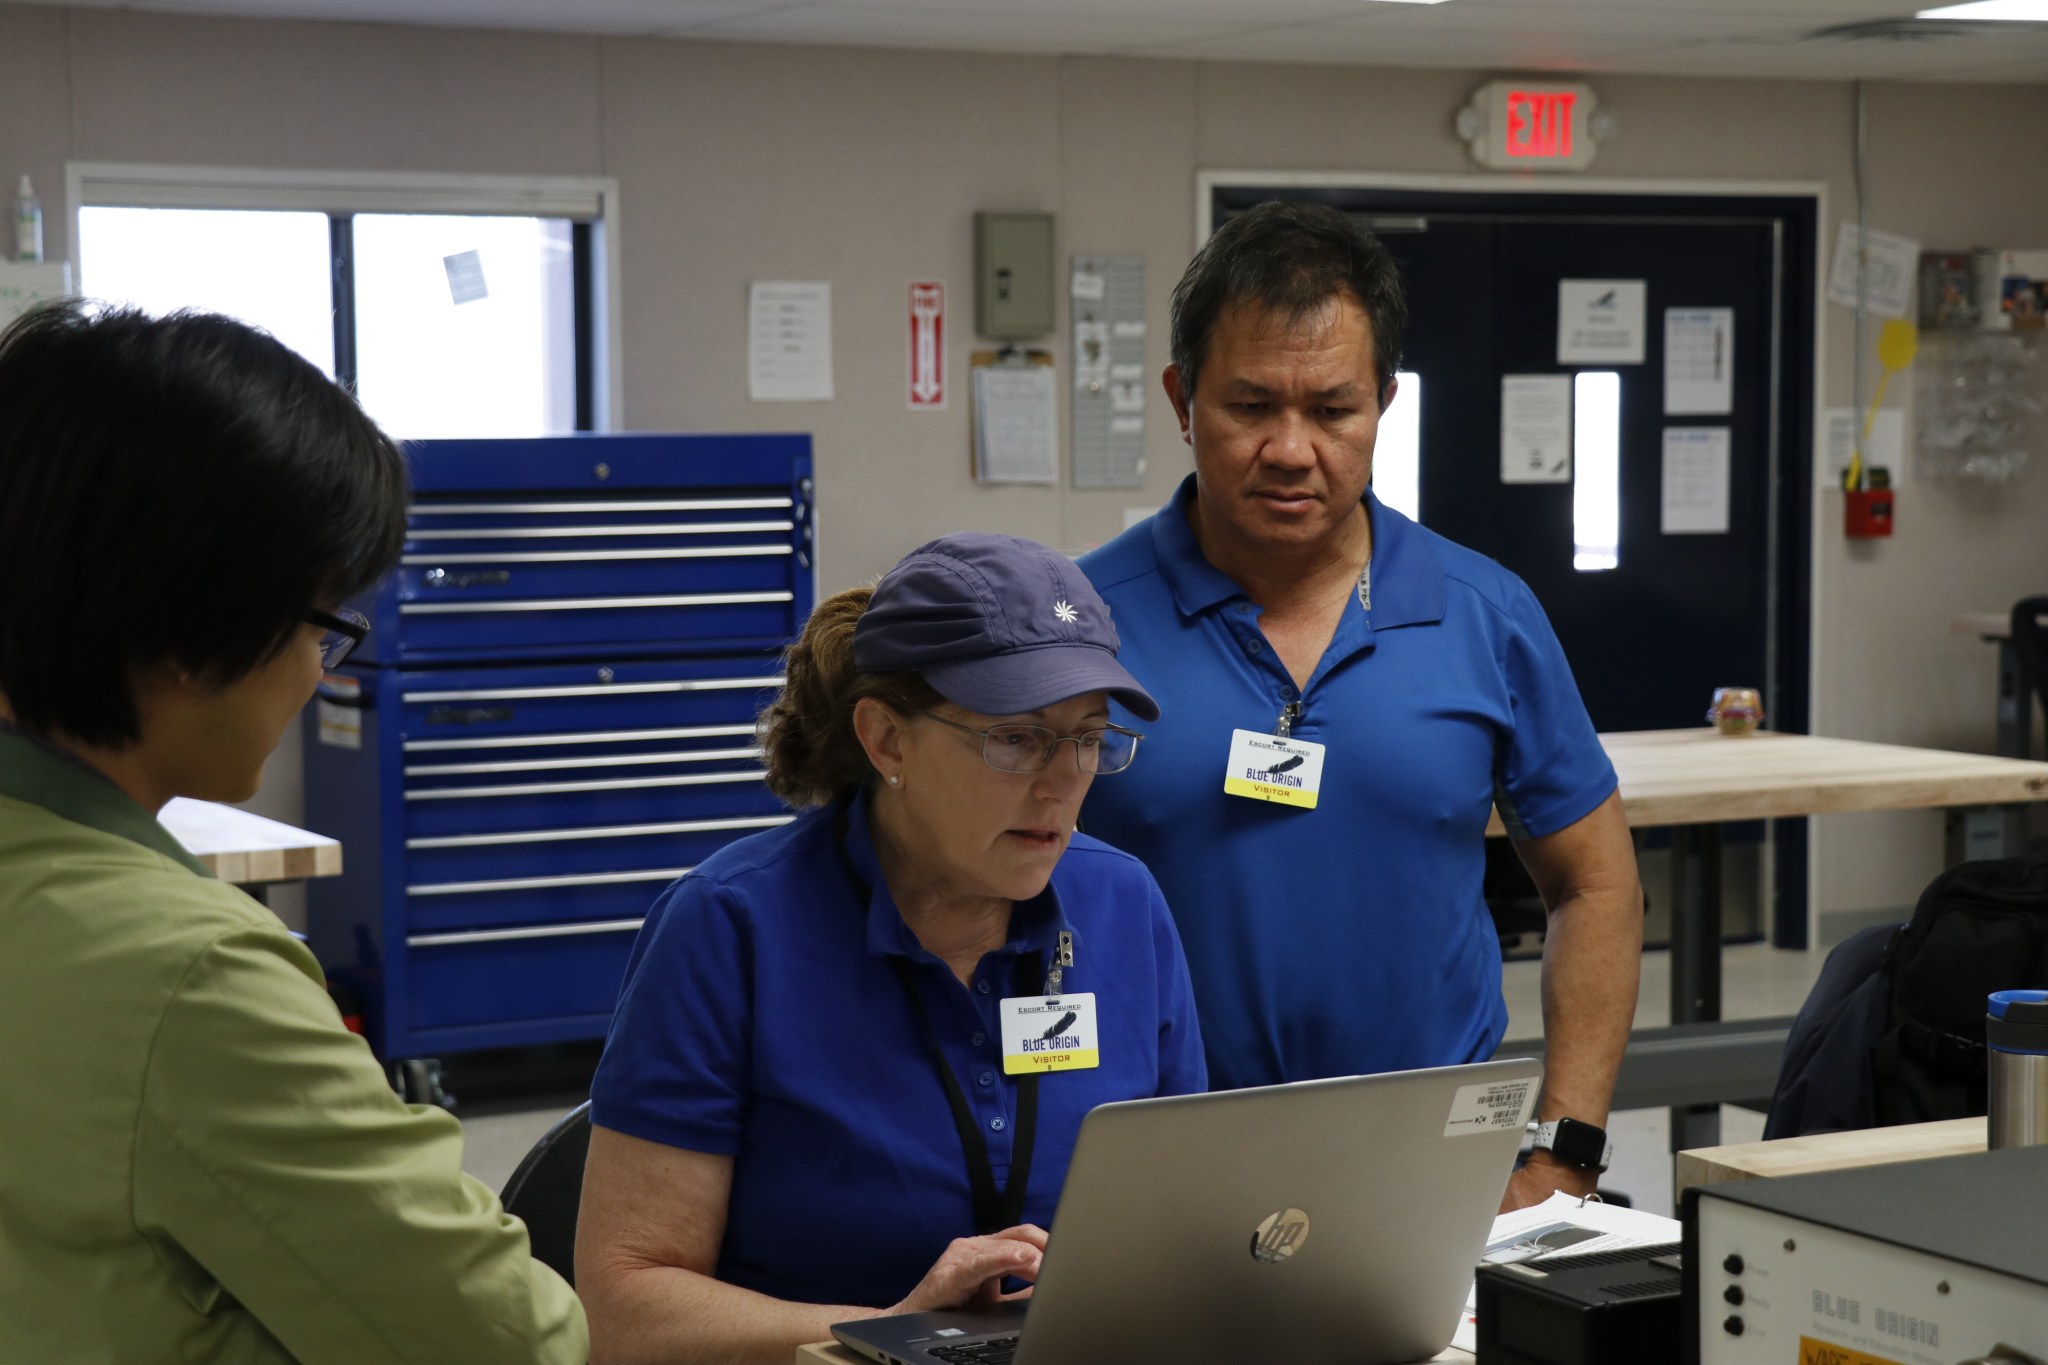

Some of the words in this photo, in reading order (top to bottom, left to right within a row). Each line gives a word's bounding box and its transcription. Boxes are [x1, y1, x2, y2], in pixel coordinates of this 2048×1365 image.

[1506, 91, 1577, 157] EXIT
[1247, 768, 1269, 781] BLUE
[1272, 773, 1302, 787] ORIGIN
[1023, 1039, 1045, 1051] BLUE
[1049, 1035, 1080, 1050] ORIGIN
[1812, 1289, 1860, 1323] BLUE
[1875, 1308, 1939, 1347] ORIGIN
